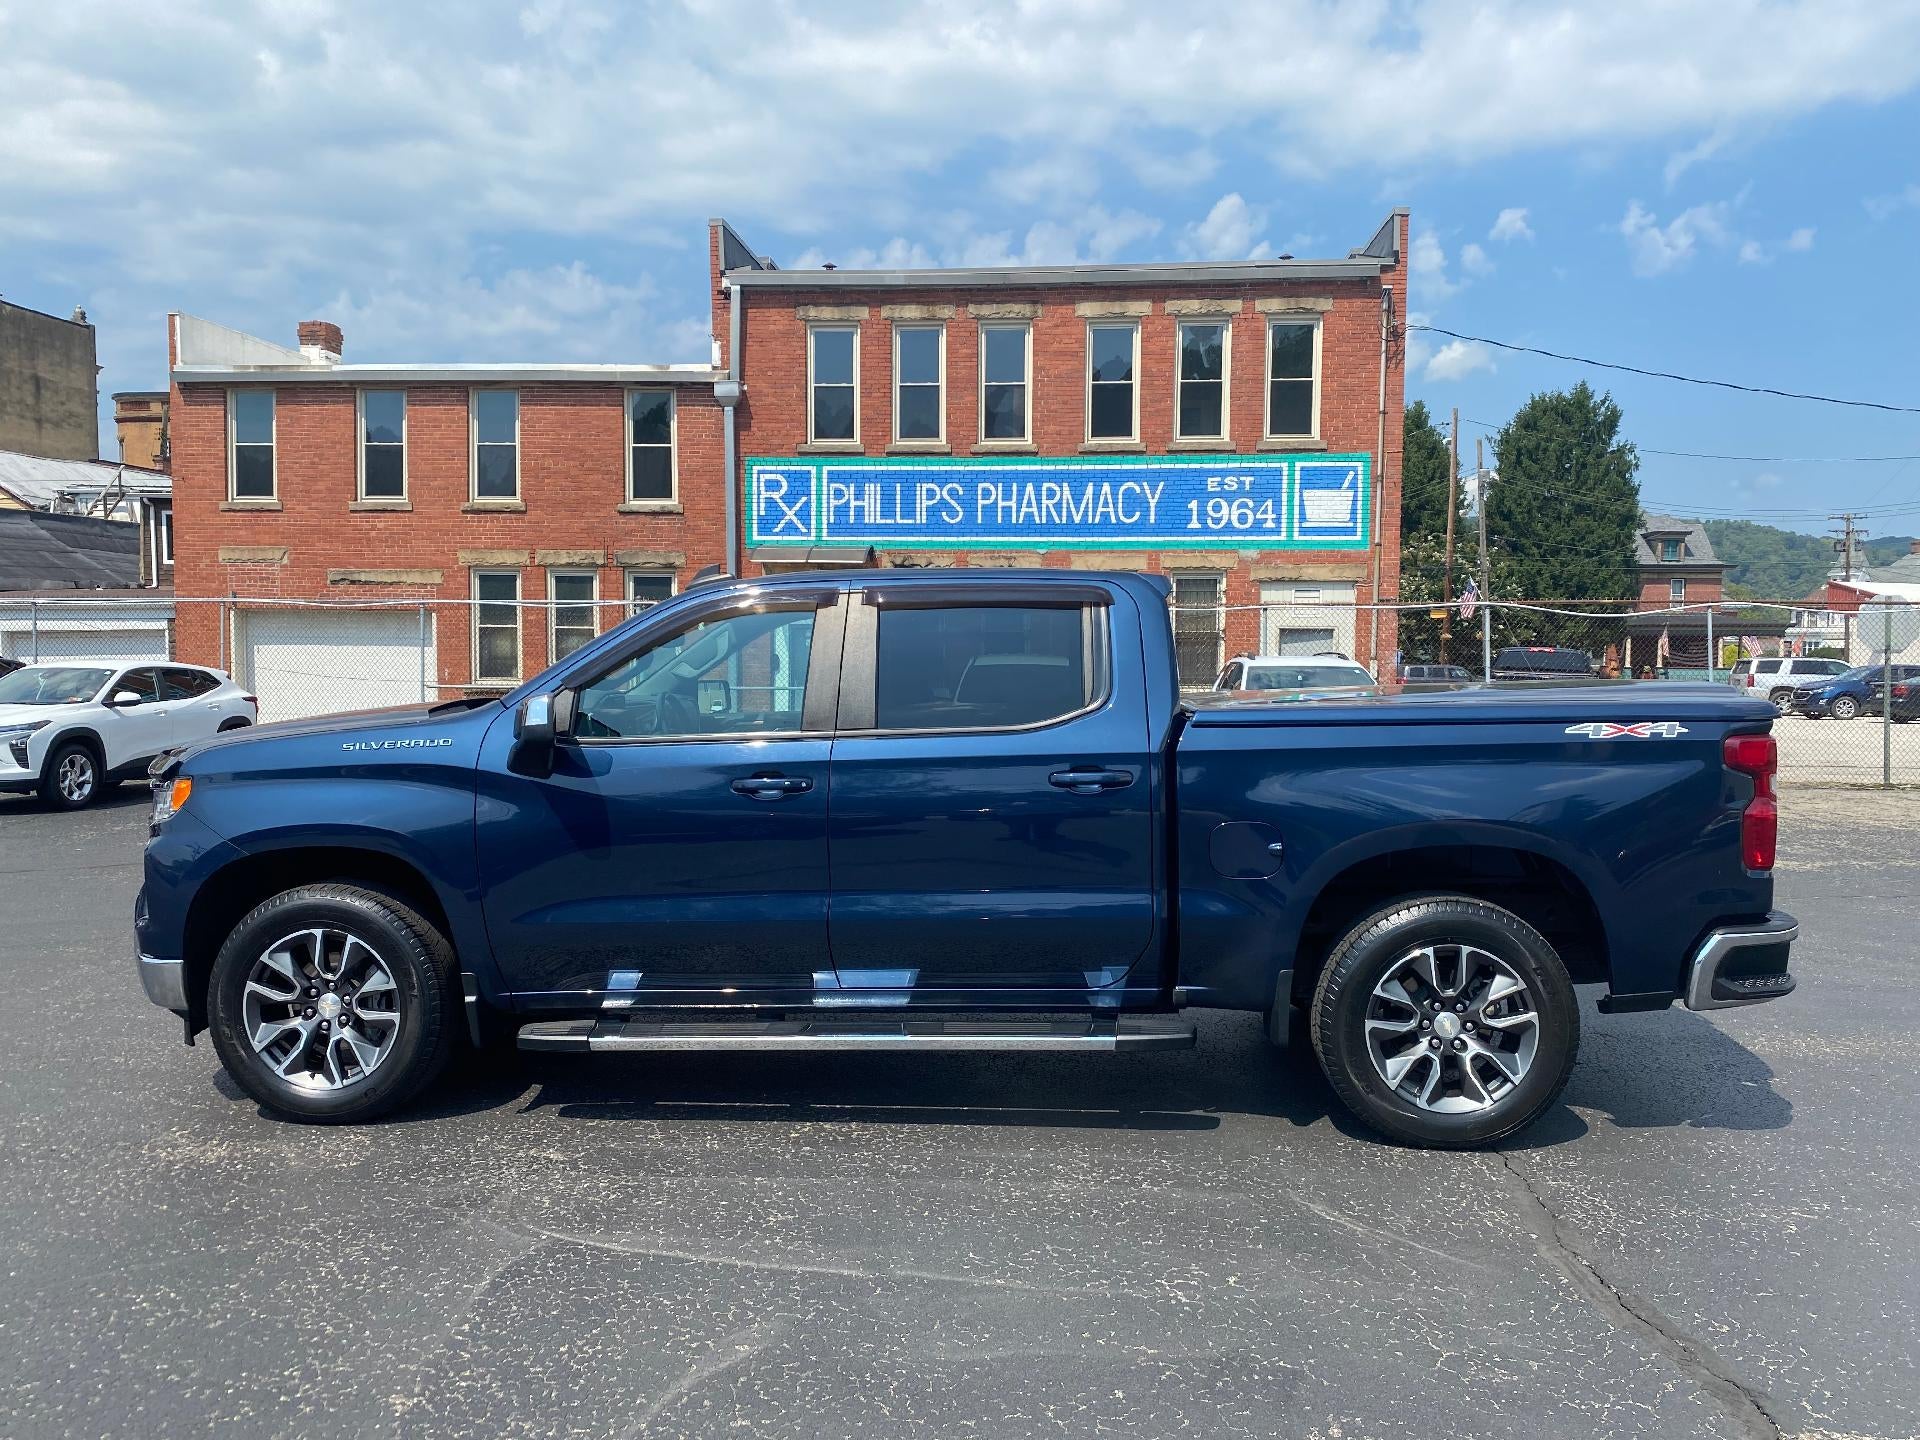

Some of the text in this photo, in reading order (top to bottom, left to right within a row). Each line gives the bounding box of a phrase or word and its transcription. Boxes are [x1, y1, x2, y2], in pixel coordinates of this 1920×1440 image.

[1206, 476, 1255, 492] EST
[829, 481, 1165, 524] PHILLIPS PHARMACY
[1187, 498, 1277, 529] 1964
[341, 738, 453, 751] SILVERADO
